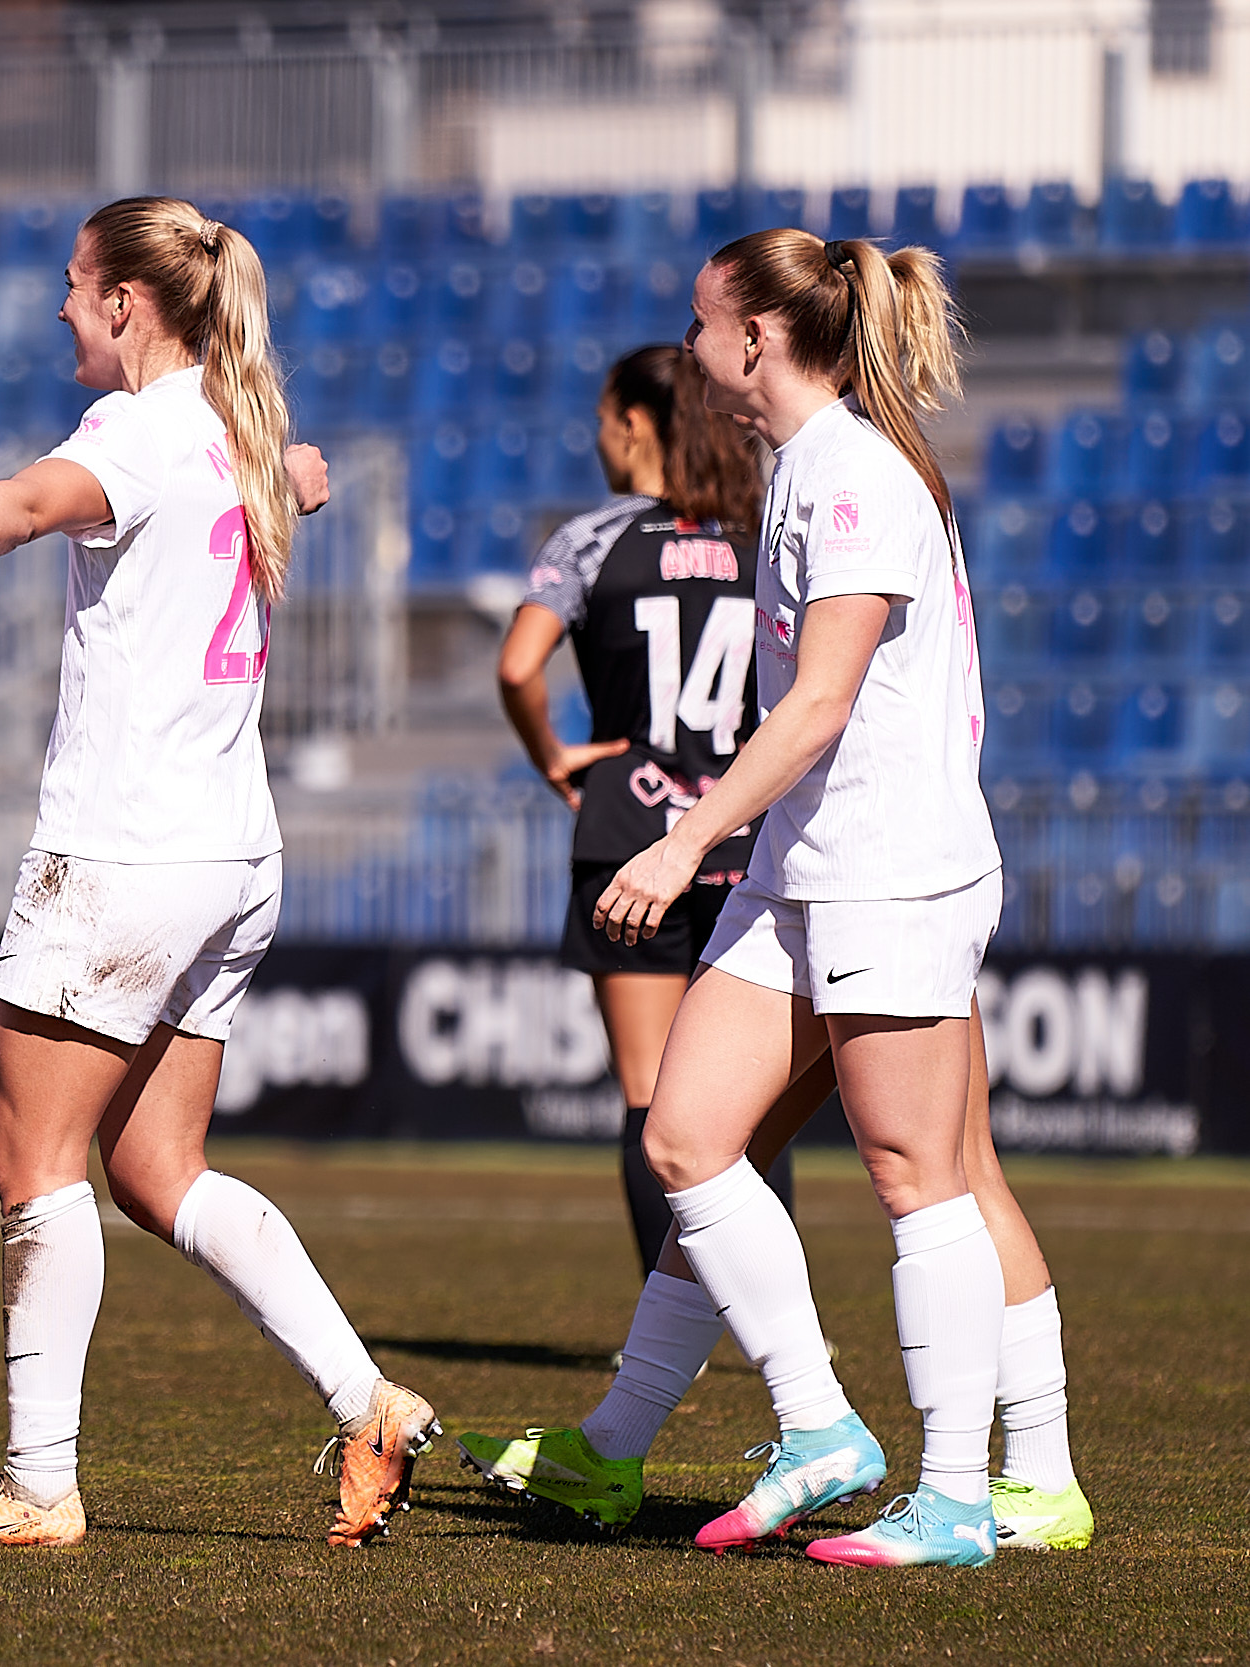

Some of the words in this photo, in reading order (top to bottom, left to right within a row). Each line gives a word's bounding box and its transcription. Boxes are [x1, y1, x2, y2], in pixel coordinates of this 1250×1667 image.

[203, 504, 273, 686] 2
[660, 539, 739, 581] ANITA
[634, 595, 756, 755] 14
